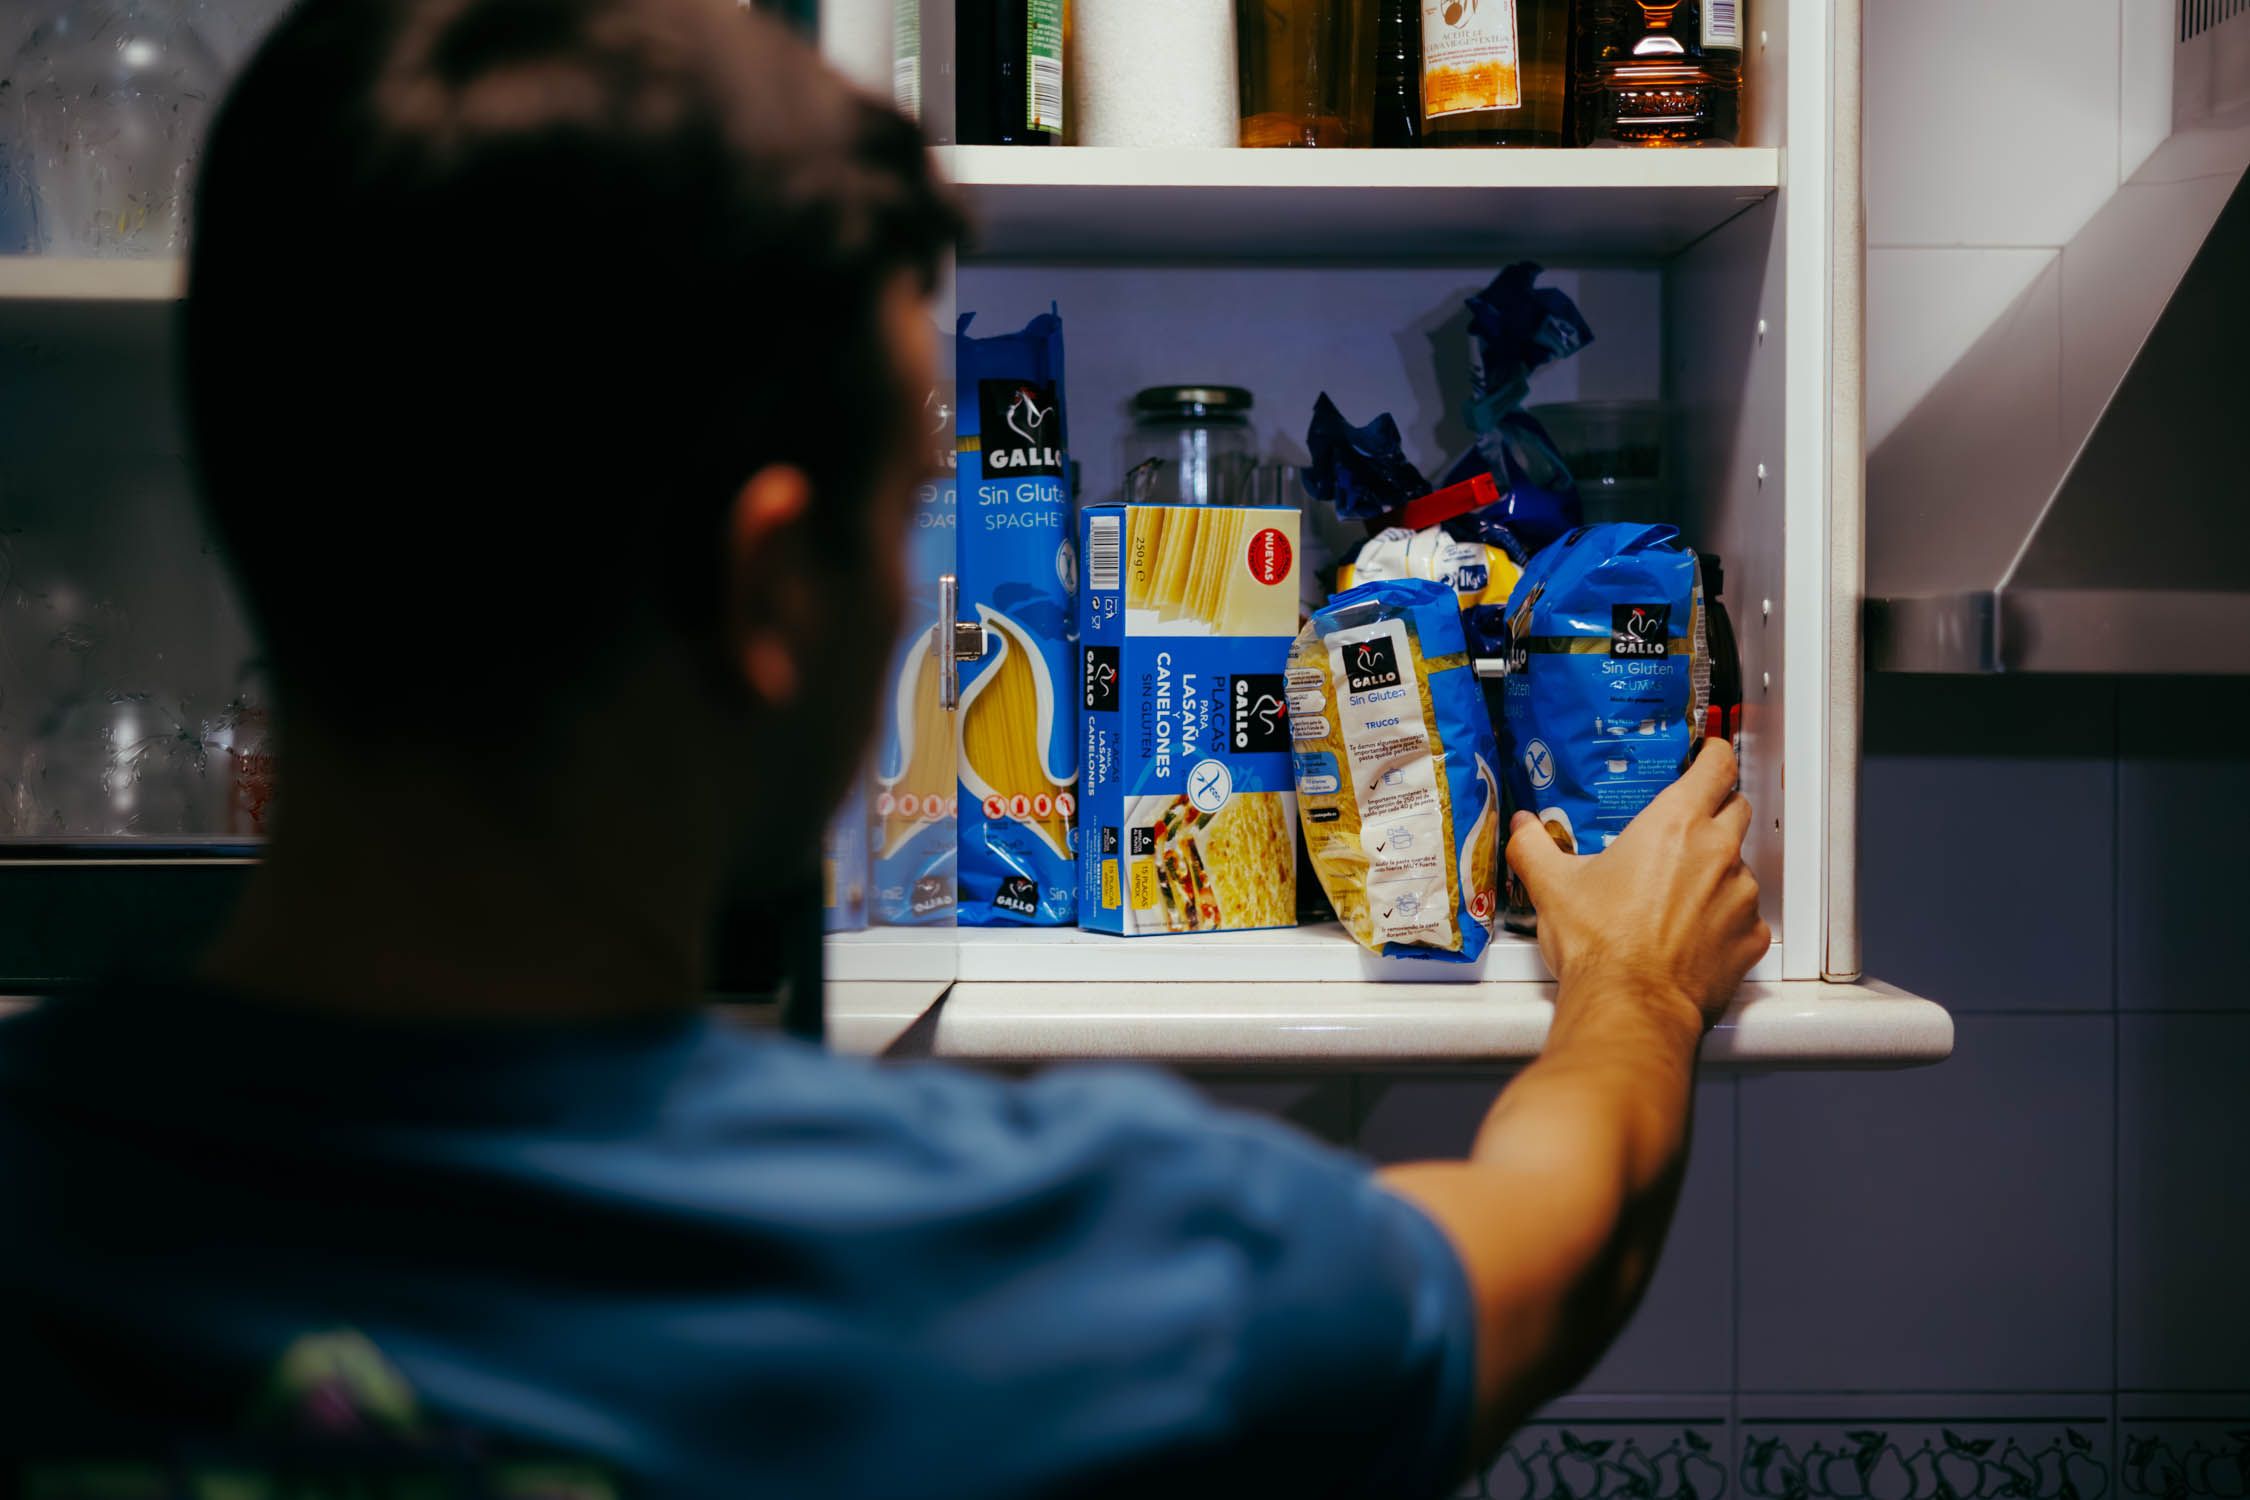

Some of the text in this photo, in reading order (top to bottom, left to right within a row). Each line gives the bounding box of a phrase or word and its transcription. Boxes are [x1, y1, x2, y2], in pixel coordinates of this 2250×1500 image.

[979, 486, 1009, 506] Sin
[1016, 484, 1064, 503] Glut
[985, 512, 1063, 530] SPAGHE
[1136, 537, 1144, 558] 250
[1264, 531, 1274, 581] NUEVAS
[1615, 642, 1665, 654] GALLO
[1601, 660, 1673, 675] Sin Gluten
[1086, 650, 1095, 707] GALLO
[1352, 672, 1396, 688] GALLO
[1349, 688, 1406, 706] Sin Gluten
[1142, 673, 1152, 759] SIN GLUTEN
[1156, 652, 1172, 779] CANELONES
[1172, 711, 1181, 719] Y
[1182, 674, 1199, 757] LASAÑA
[1200, 700, 1209, 730] PARA
[1211, 676, 1226, 753] PLACAS
[1236, 680, 1249, 748] GALLO
[1366, 717, 1400, 729] TRUCOS
[1087, 716, 1096, 797] CANELONES
[1098, 730, 1107, 784] LASAÑA
[1142, 837, 1152, 845] 6
[996, 894, 1035, 914] GALLO
[1050, 887, 1068, 901] Sin
